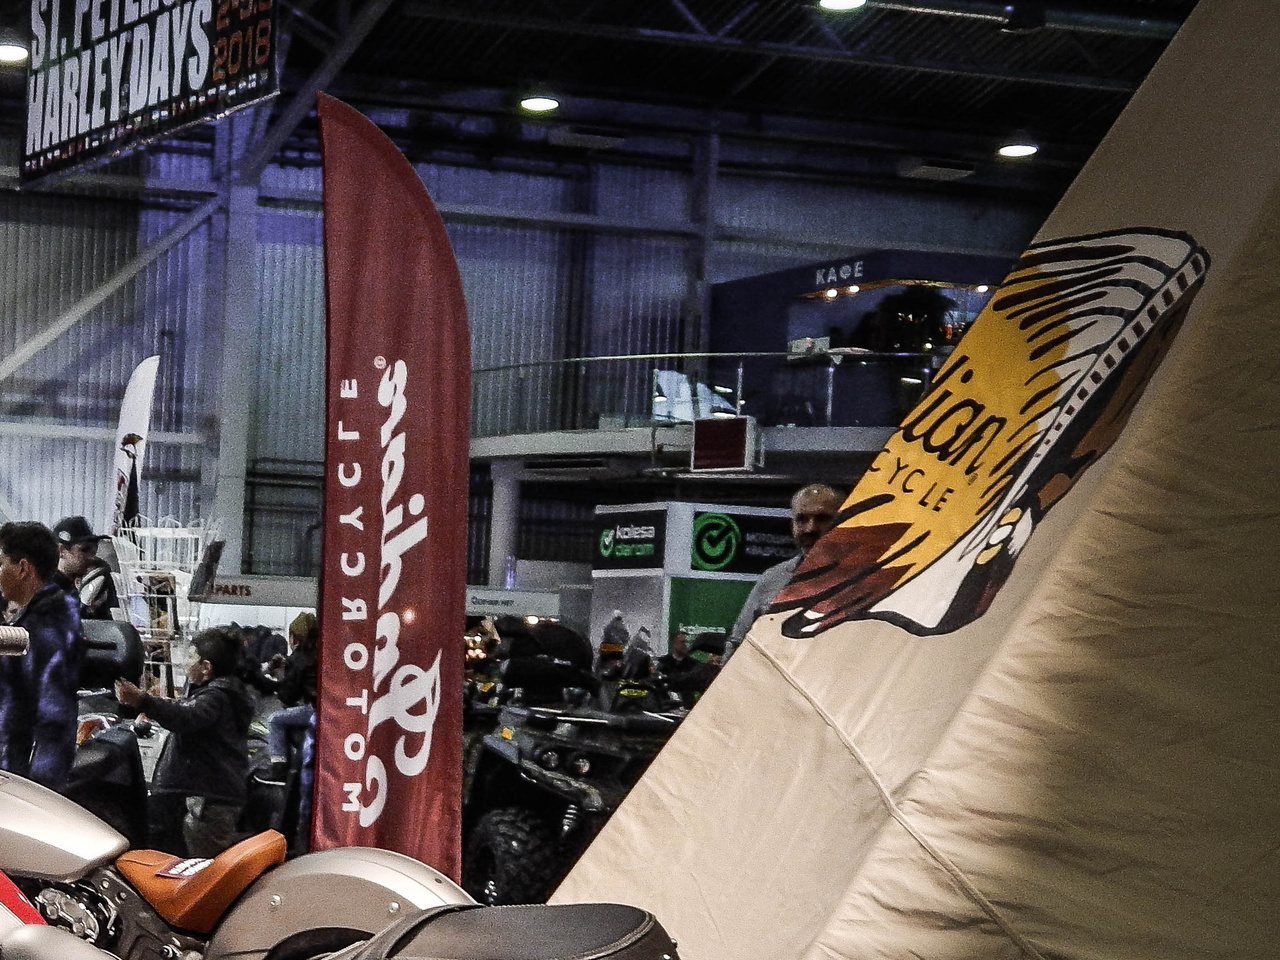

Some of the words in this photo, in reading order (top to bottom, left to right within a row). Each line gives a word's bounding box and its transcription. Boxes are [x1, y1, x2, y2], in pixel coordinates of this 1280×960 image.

[26, 34, 125, 156] HARLEY
[129, 0, 212, 115] DAYS
[212, 18, 273, 81] 2018
[816, 261, 864, 285] КАФЕ
